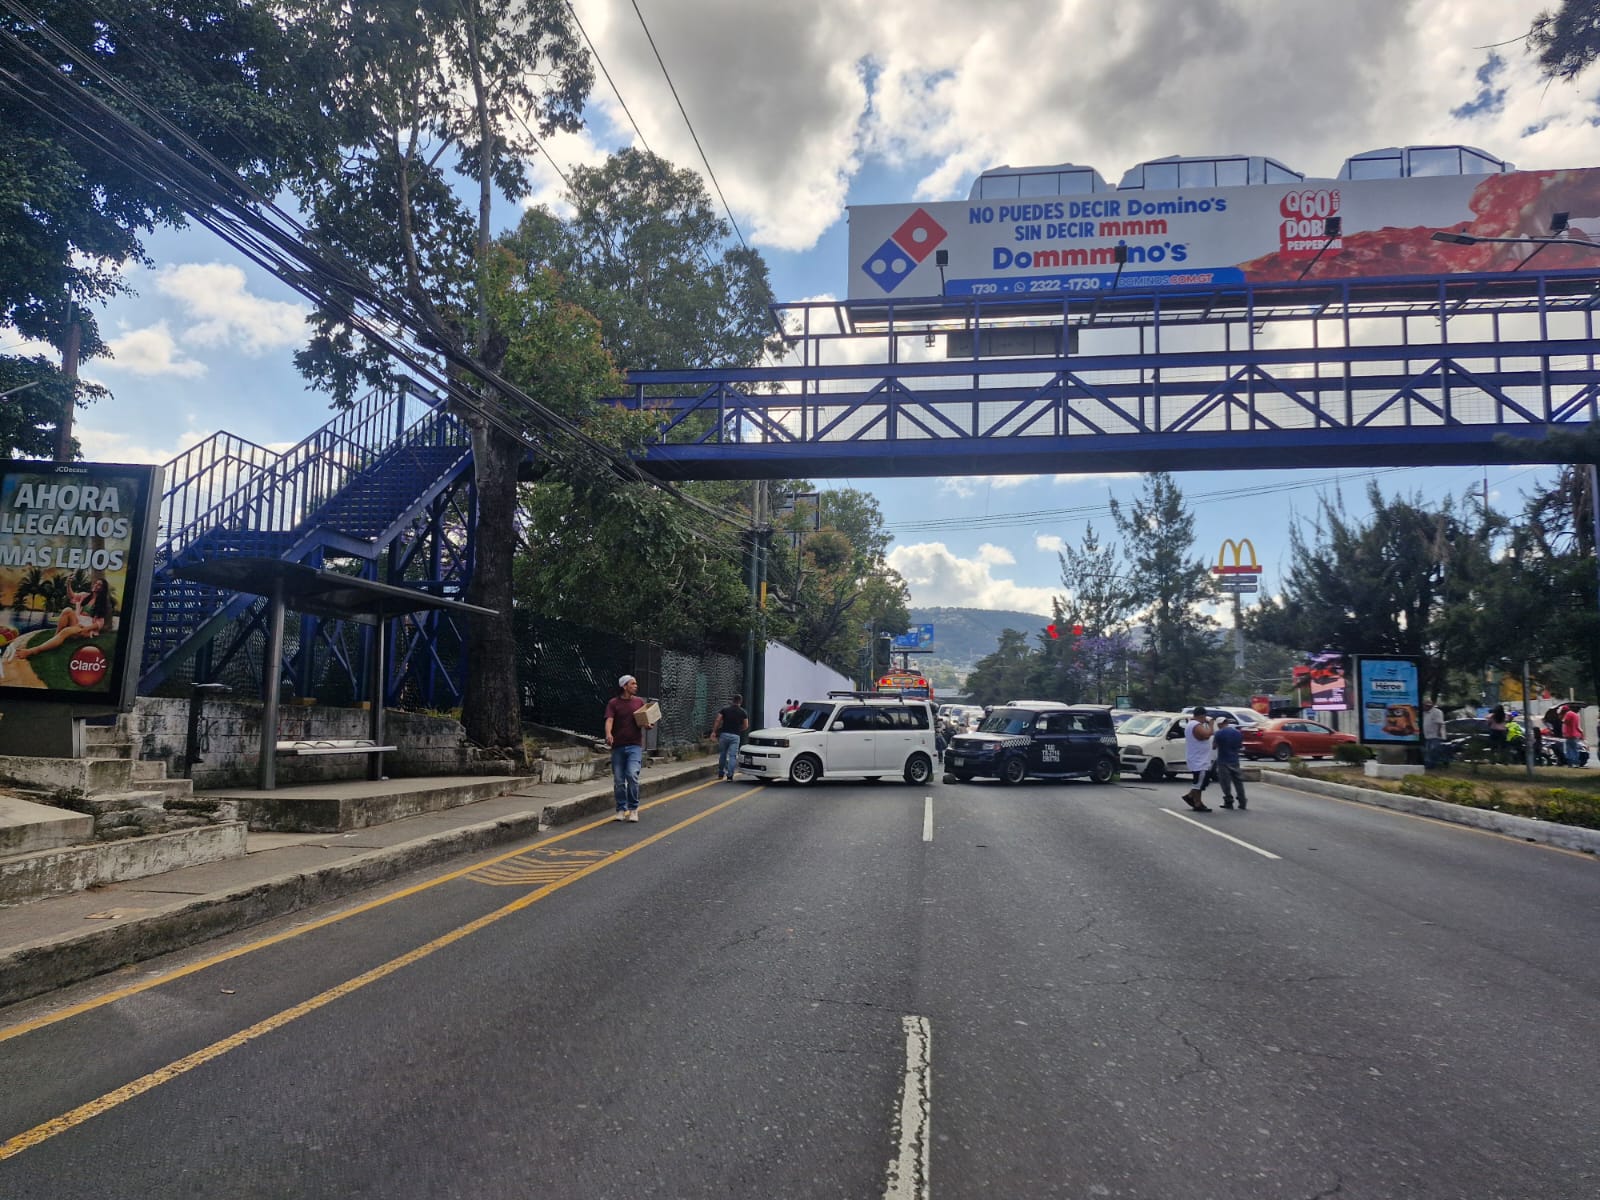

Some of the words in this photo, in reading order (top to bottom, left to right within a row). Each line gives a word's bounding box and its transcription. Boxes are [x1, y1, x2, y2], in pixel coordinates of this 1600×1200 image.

[969, 206, 994, 224] NO
[1000, 202, 1064, 222] PUEDES
[1069, 200, 1120, 219] DECIR
[1128, 196, 1227, 216] Domino's
[1285, 189, 1331, 218] Q60
[1015, 224, 1042, 242] SIN
[1046, 221, 1094, 240] DECIR
[1099, 219, 1167, 237] mmm
[1286, 219, 1341, 238] DOB
[993, 240, 1188, 270] Dommmno's
[971, 284, 997, 295] 1730
[55, 466, 88, 474] JCDecaux
[14, 483, 120, 513] AHORA
[0, 512, 129, 539] LLEGAMOS
[0, 540, 52, 567] MÁS
[55, 546, 124, 571] LEJOS
[70, 658, 103, 672] Claro
